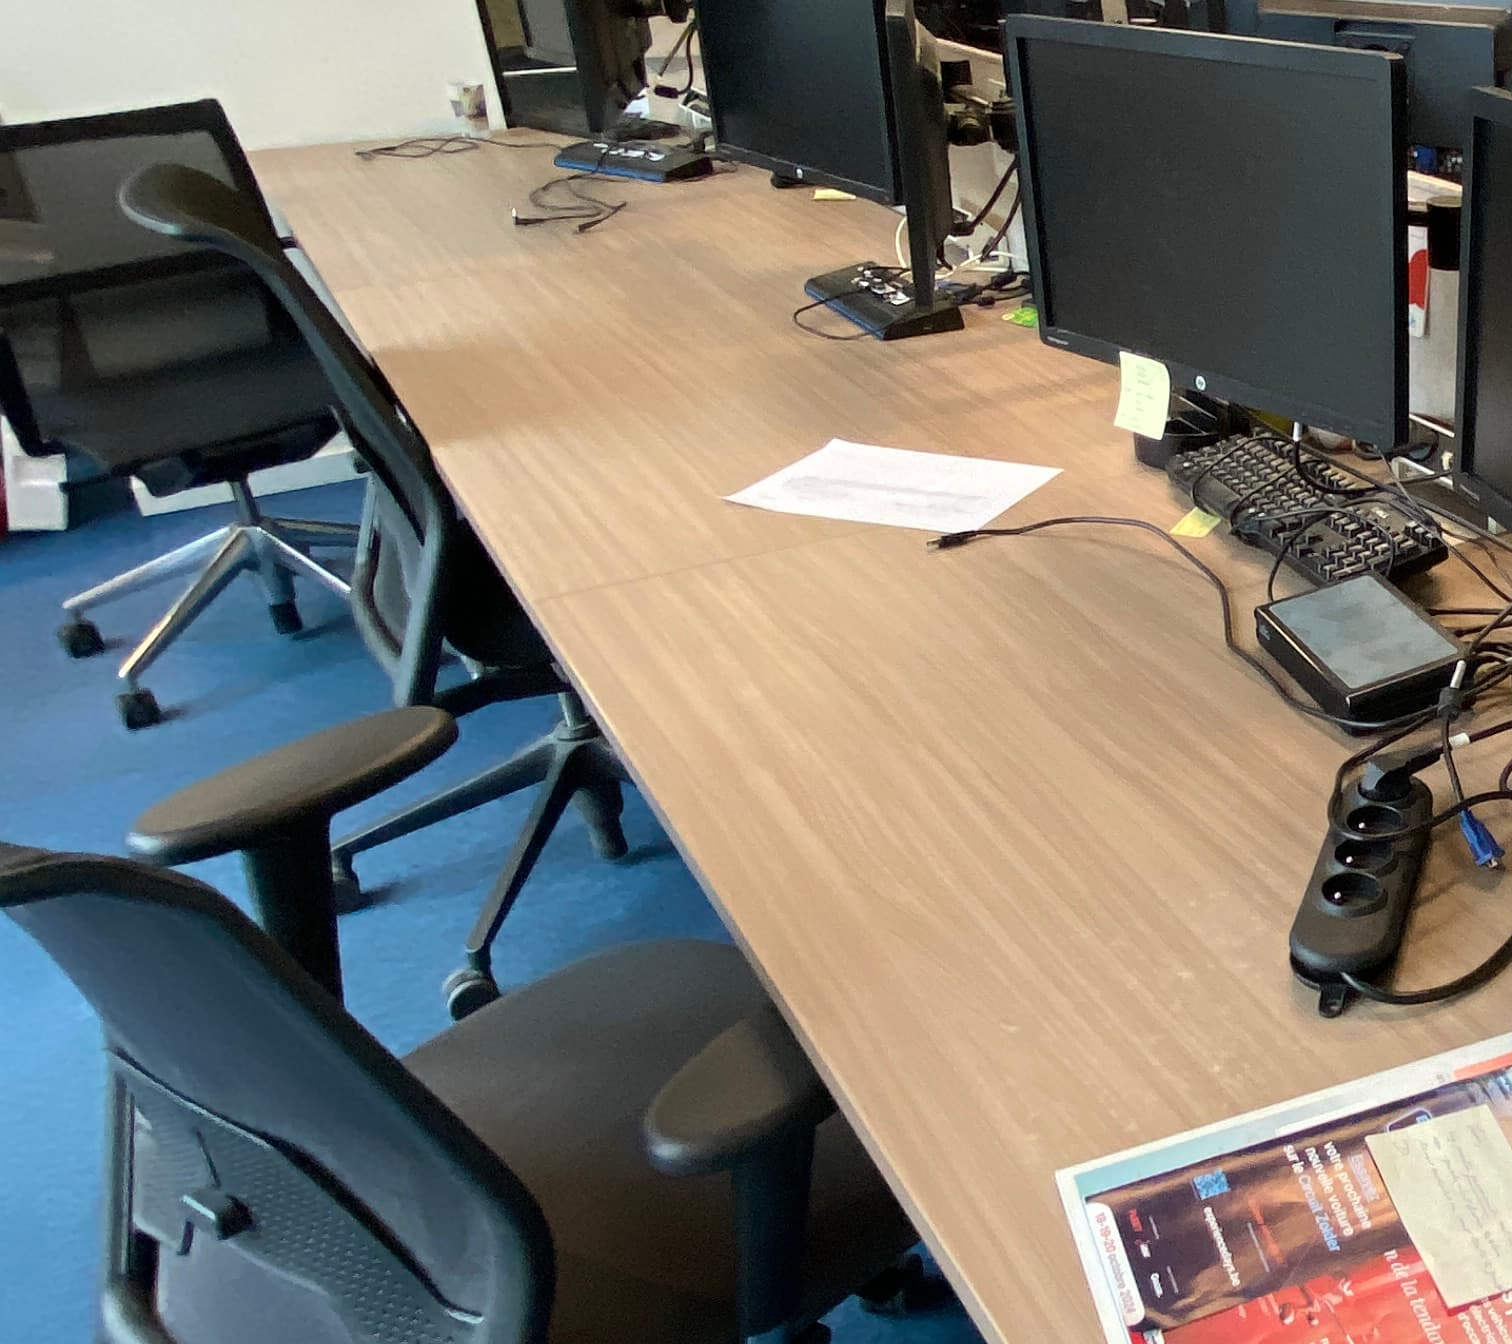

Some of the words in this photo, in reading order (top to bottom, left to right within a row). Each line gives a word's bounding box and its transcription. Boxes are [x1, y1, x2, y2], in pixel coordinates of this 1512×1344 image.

[1283, 1144, 1300, 1163] sur
[1292, 1161, 1305, 1174] le
[1299, 1175, 1323, 1213] Circuit
[1315, 1213, 1341, 1252] Zolder
[1305, 1147, 1334, 1193] nouvelle
[1328, 1193, 1354, 1237] voiture
[1323, 1141, 1344, 1171] votre
[1337, 1171, 1372, 1229] prochaine
[1391, 1262, 1410, 1278] de
[1401, 1277, 1419, 1296] la
